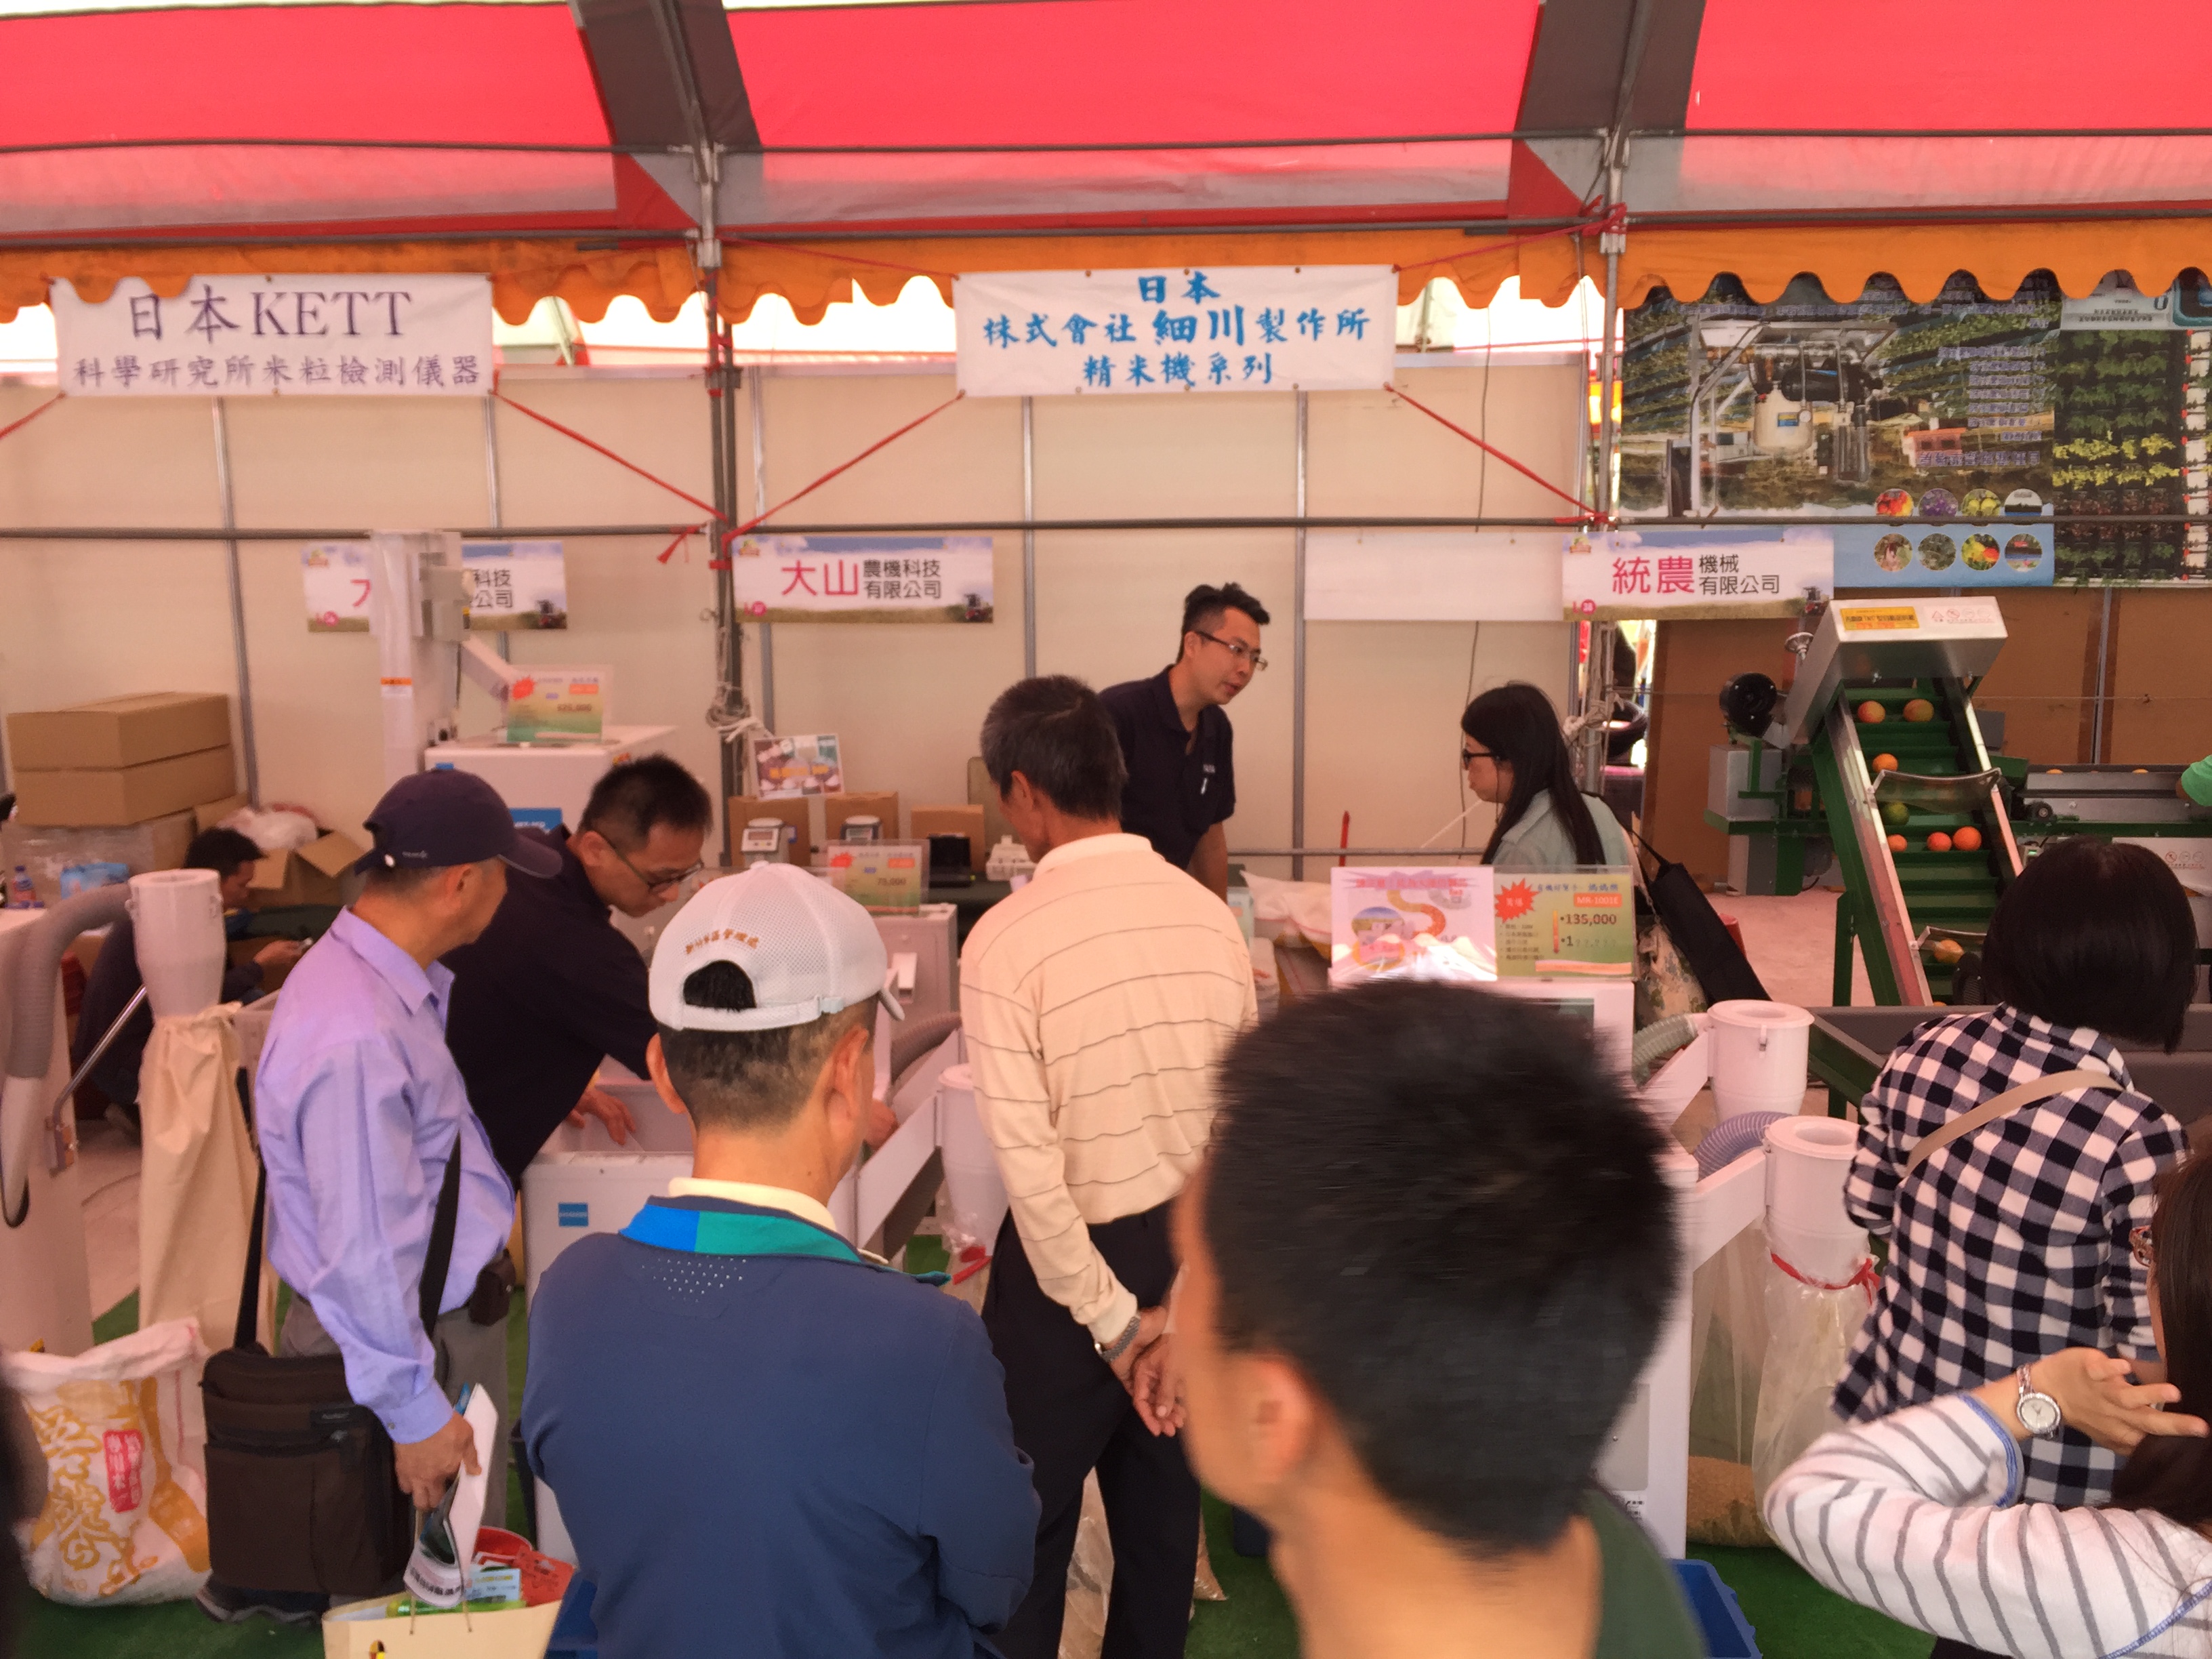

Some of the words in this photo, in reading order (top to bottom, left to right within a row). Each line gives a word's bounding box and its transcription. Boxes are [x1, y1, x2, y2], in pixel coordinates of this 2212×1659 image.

[1137, 271, 1221, 304] 日本
[73, 354, 480, 388] 科學研究所米粒檢測儀器
[1083, 352, 1272, 388] 精米機系列
[863, 559, 941, 578] 農機科技
[1611, 555, 1695, 595] 統農
[1698, 554, 1740, 573] 機械
[781, 559, 859, 596] 大山
[863, 580, 942, 600] 有限公司
[1698, 575, 1780, 596] 有限公司
[1566, 914, 1617, 926] 135,000
